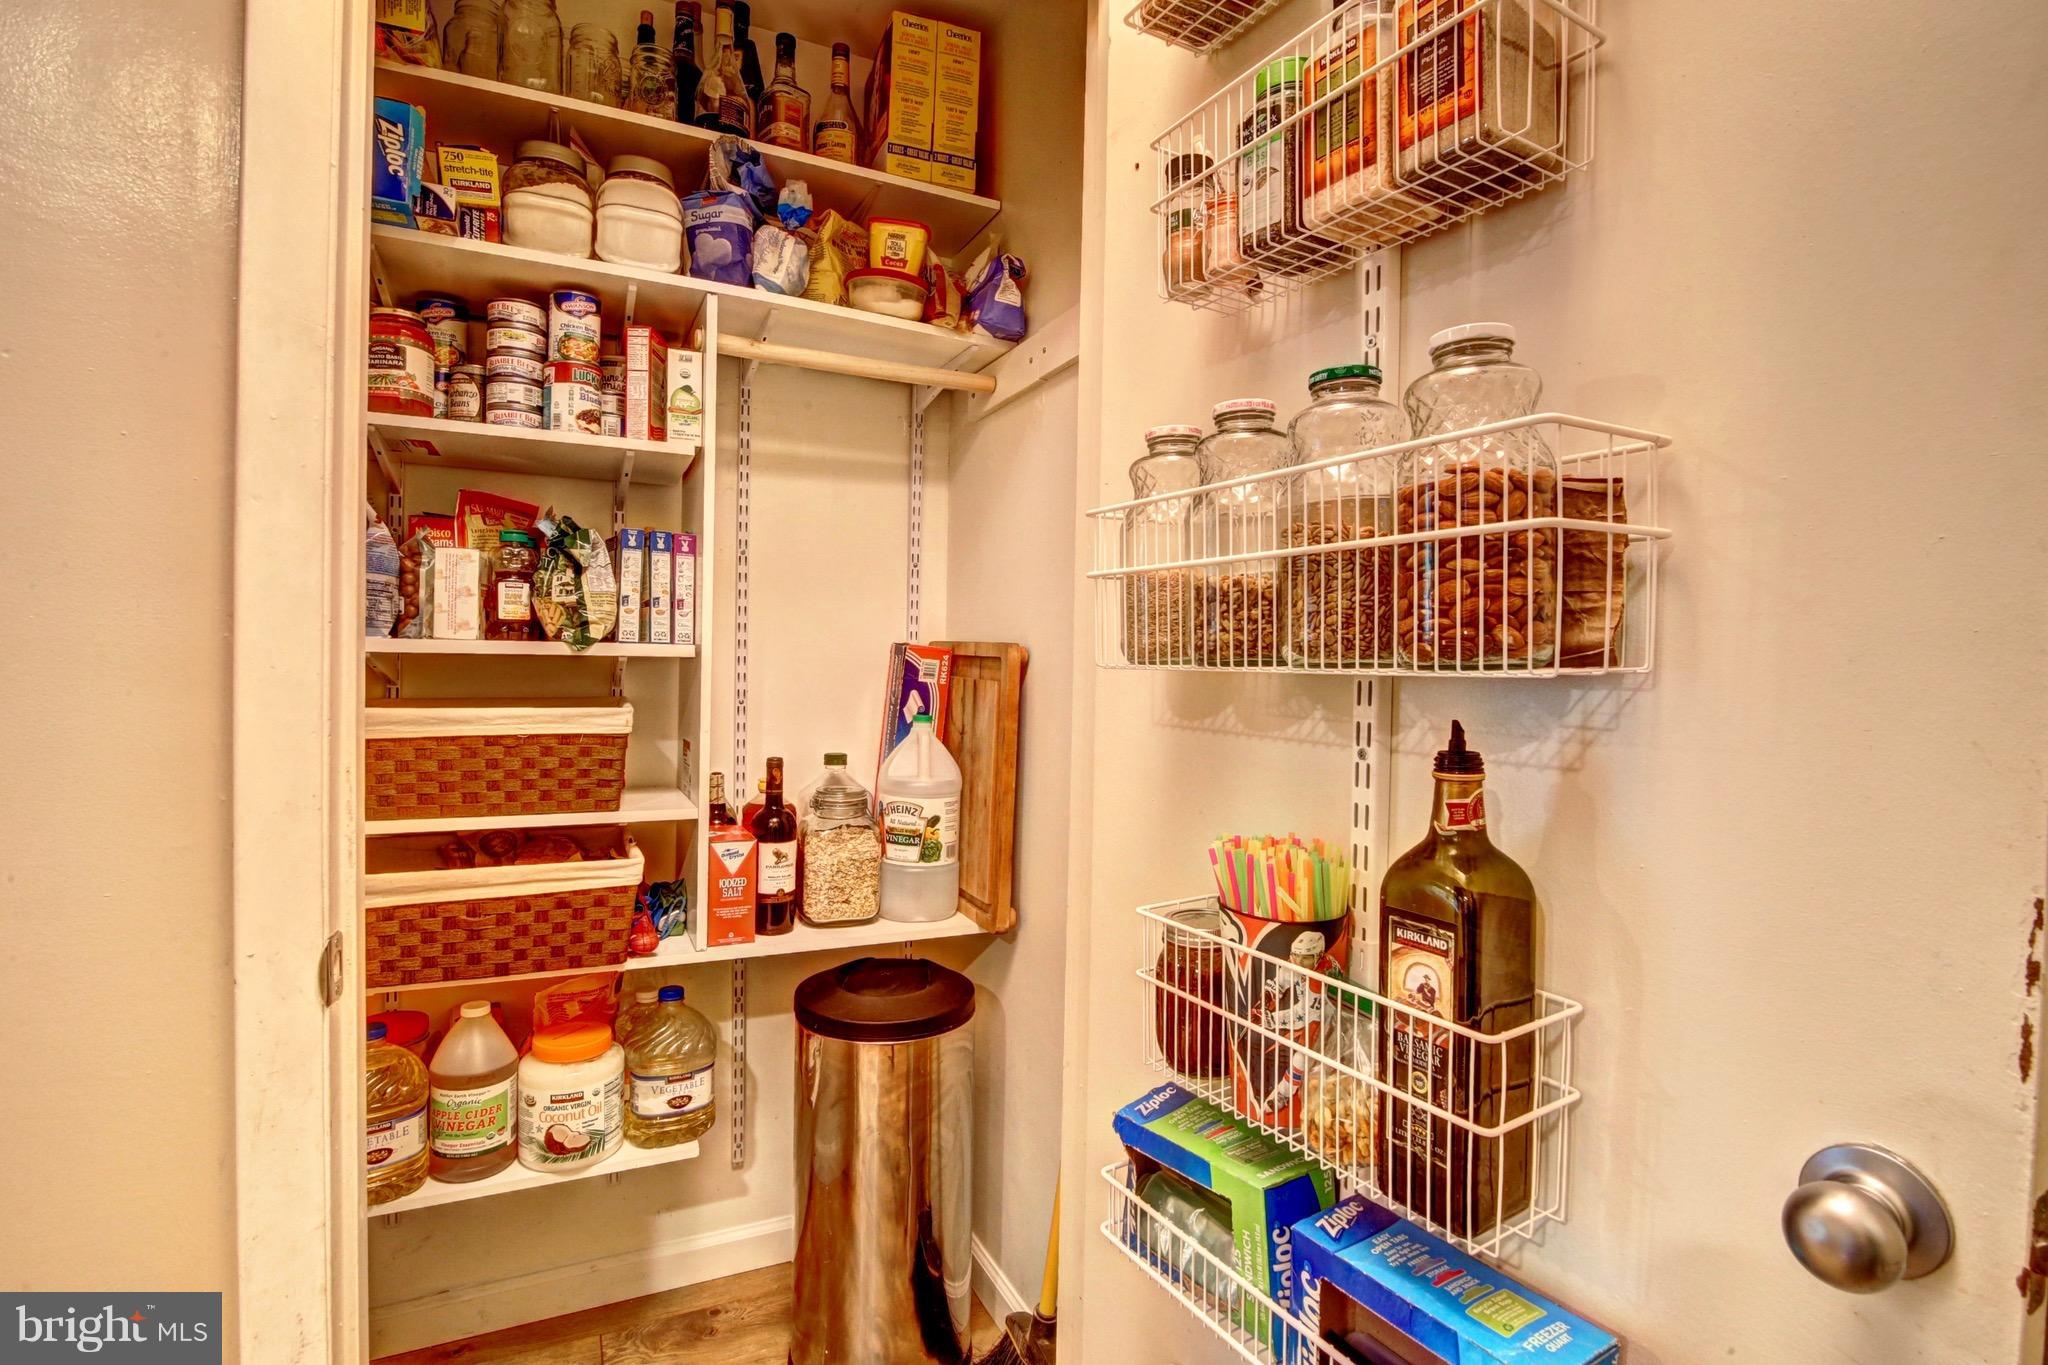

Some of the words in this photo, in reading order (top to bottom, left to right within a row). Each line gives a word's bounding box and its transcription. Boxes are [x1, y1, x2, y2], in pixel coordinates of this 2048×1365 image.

[902, 19, 928, 32] Cheerios
[946, 29, 973, 42] Cheerios
[1321, 38, 1357, 66] KRKLND
[1421, 46, 1448, 65] PEPER
[377, 118, 406, 178] Ziploc
[443, 151, 464, 161] 750
[444, 164, 494, 177] stretch-tite
[452, 180, 491, 189] KIRKLAND
[691, 211, 723, 222] Sugar
[885, 259, 903, 267] Cocoa
[565, 303, 595, 311] SWANSON
[560, 322, 582, 331] Chicken
[449, 389, 478, 399] arbanzo
[415, 527, 451, 537] Nisco
[939, 655, 950, 685] RK624
[890, 805, 919, 817] HEINZ
[886, 834, 921, 846] VINEGAR
[719, 877, 748, 888] IODIZED
[722, 887, 744, 898] SALT
[1396, 927, 1448, 951] KIRKLAND
[1397, 1031, 1443, 1059] BASAIC
[651, 1076, 705, 1095] VEGETABLE
[551, 1092, 583, 1101] KIRKLAND
[1134, 1086, 1177, 1117] Ziploc
[433, 1109, 461, 1120] APPLE
[465, 1103, 503, 1120] CIDER
[446, 1098, 482, 1111] Organic
[539, 1109, 585, 1123] Coconut
[587, 1101, 602, 1117] Oil
[543, 1104, 569, 1112] ORGANIC
[570, 1100, 592, 1110] VIRGIN
[433, 1116, 496, 1132] VINEGAR
[367, 1125, 410, 1147] ETABLE
[1256, 1155, 1308, 1180] SANDWIC
[1323, 1170, 1333, 1195] 125
[1315, 1201, 1365, 1239] Ziploc
[1371, 1241, 1393, 1255] OPEN
[1272, 1225, 1293, 1309] iploc
[1301, 1270, 1321, 1365] iploc
[1522, 1320, 1572, 1353] FREEZER
[1545, 1332, 1574, 1353] QUART
